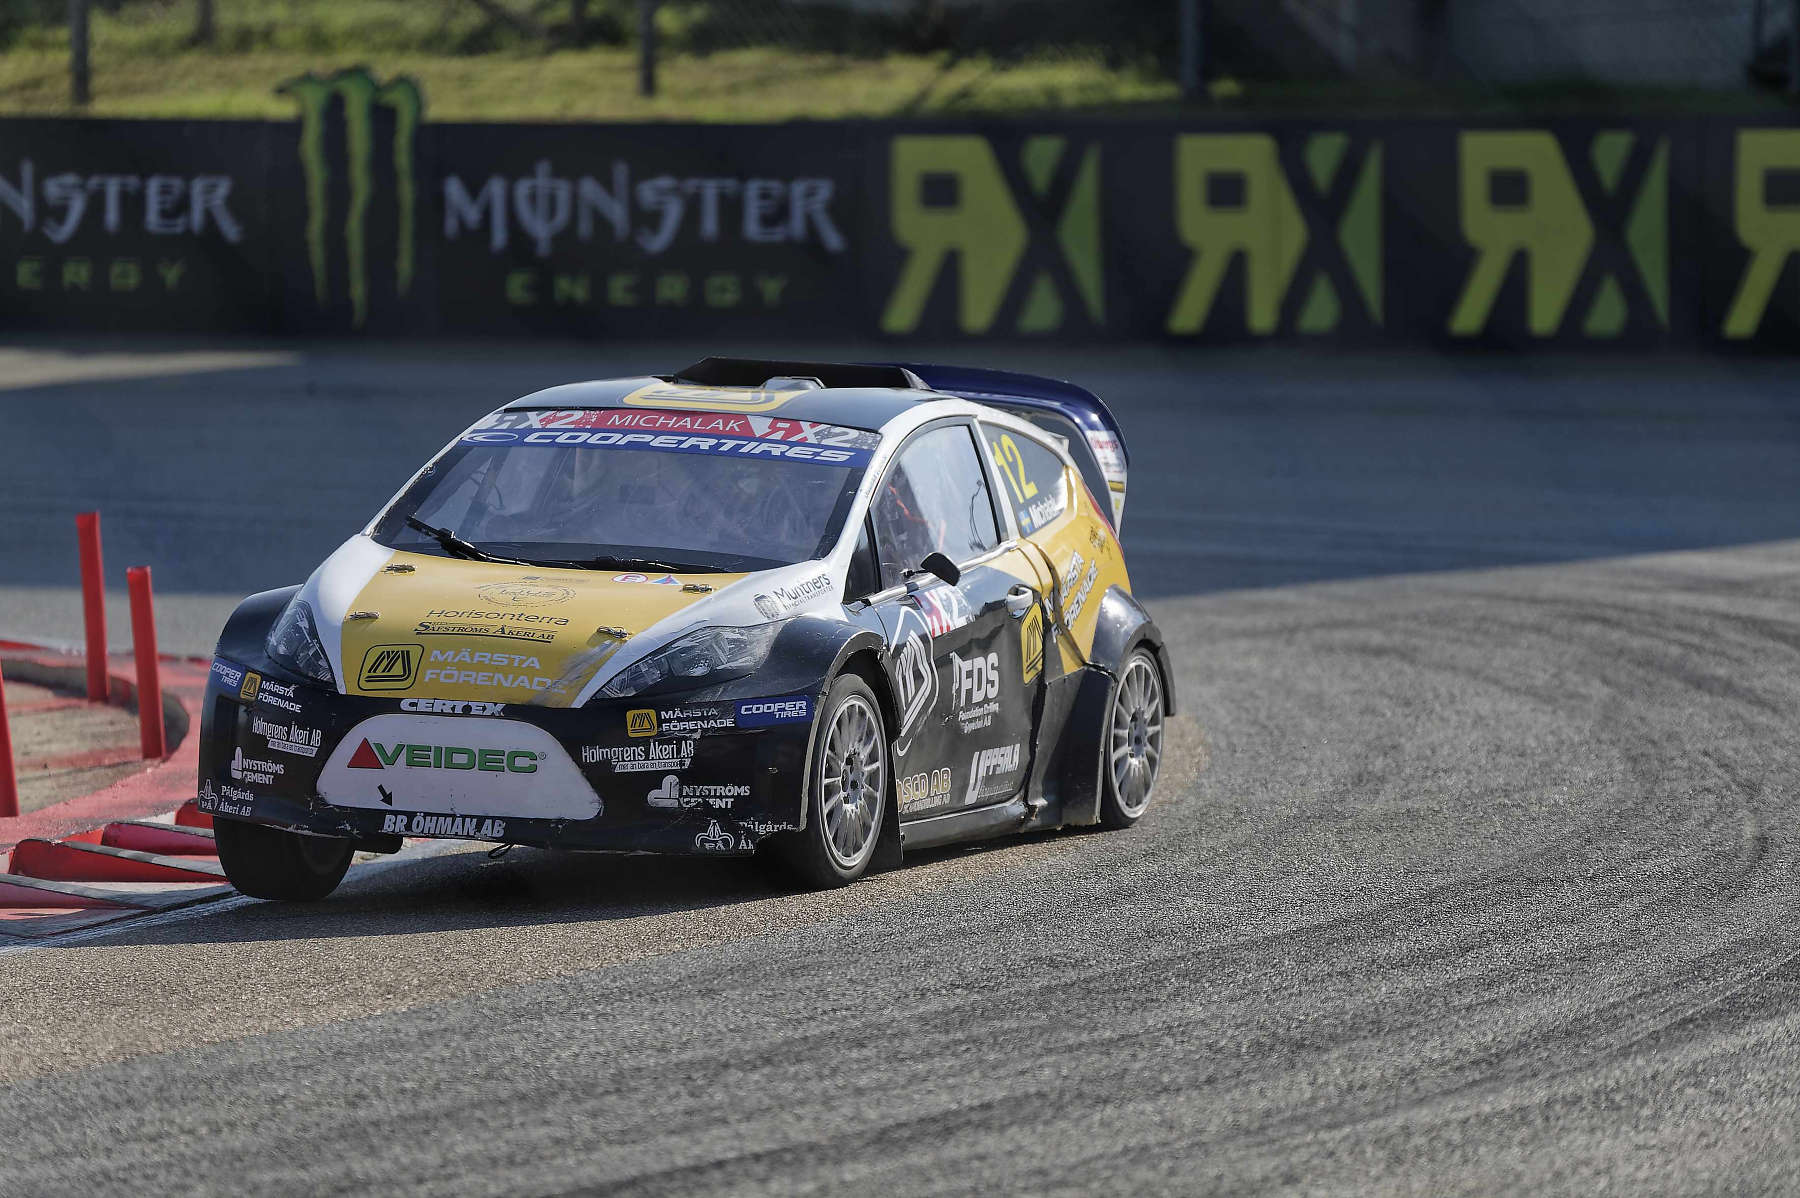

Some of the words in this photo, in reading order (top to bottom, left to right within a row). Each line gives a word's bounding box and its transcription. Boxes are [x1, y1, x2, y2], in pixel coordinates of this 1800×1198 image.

[504, 271, 790, 307] ENERGY
[607, 413, 744, 432] MICHALAK
[992, 433, 1039, 504] 12
[426, 609, 570, 627] Horisonterra
[429, 647, 540, 669] MÄRSTA
[211, 662, 242, 681] COOPER
[220, 674, 238, 687] TIRES
[960, 651, 999, 707] FDS
[261, 680, 295, 698] MÄRSTA
[258, 692, 302, 713] FÖRENADE
[400, 698, 506, 717] CERTEX
[740, 700, 807, 715] COOPER
[660, 707, 719, 720] MÄRSTA
[773, 709, 807, 719] TIRES
[252, 716, 288, 741] Holmgrens
[289, 720, 310, 745] Åkeri
[310, 728, 322, 747] AB
[662, 718, 735, 732] FÖRENADE
[581, 744, 645, 765] Holmgrens
[649, 739, 677, 760] Åkeri
[679, 740, 694, 757] AB
[242, 756, 285, 775] NYSTRÖMS
[242, 770, 274, 785] CEMENT
[682, 783, 751, 796] NYSTRÖMS
[383, 814, 406, 832] BR
[411, 812, 476, 836] ÖHMAN
[479, 819, 506, 837] AB
